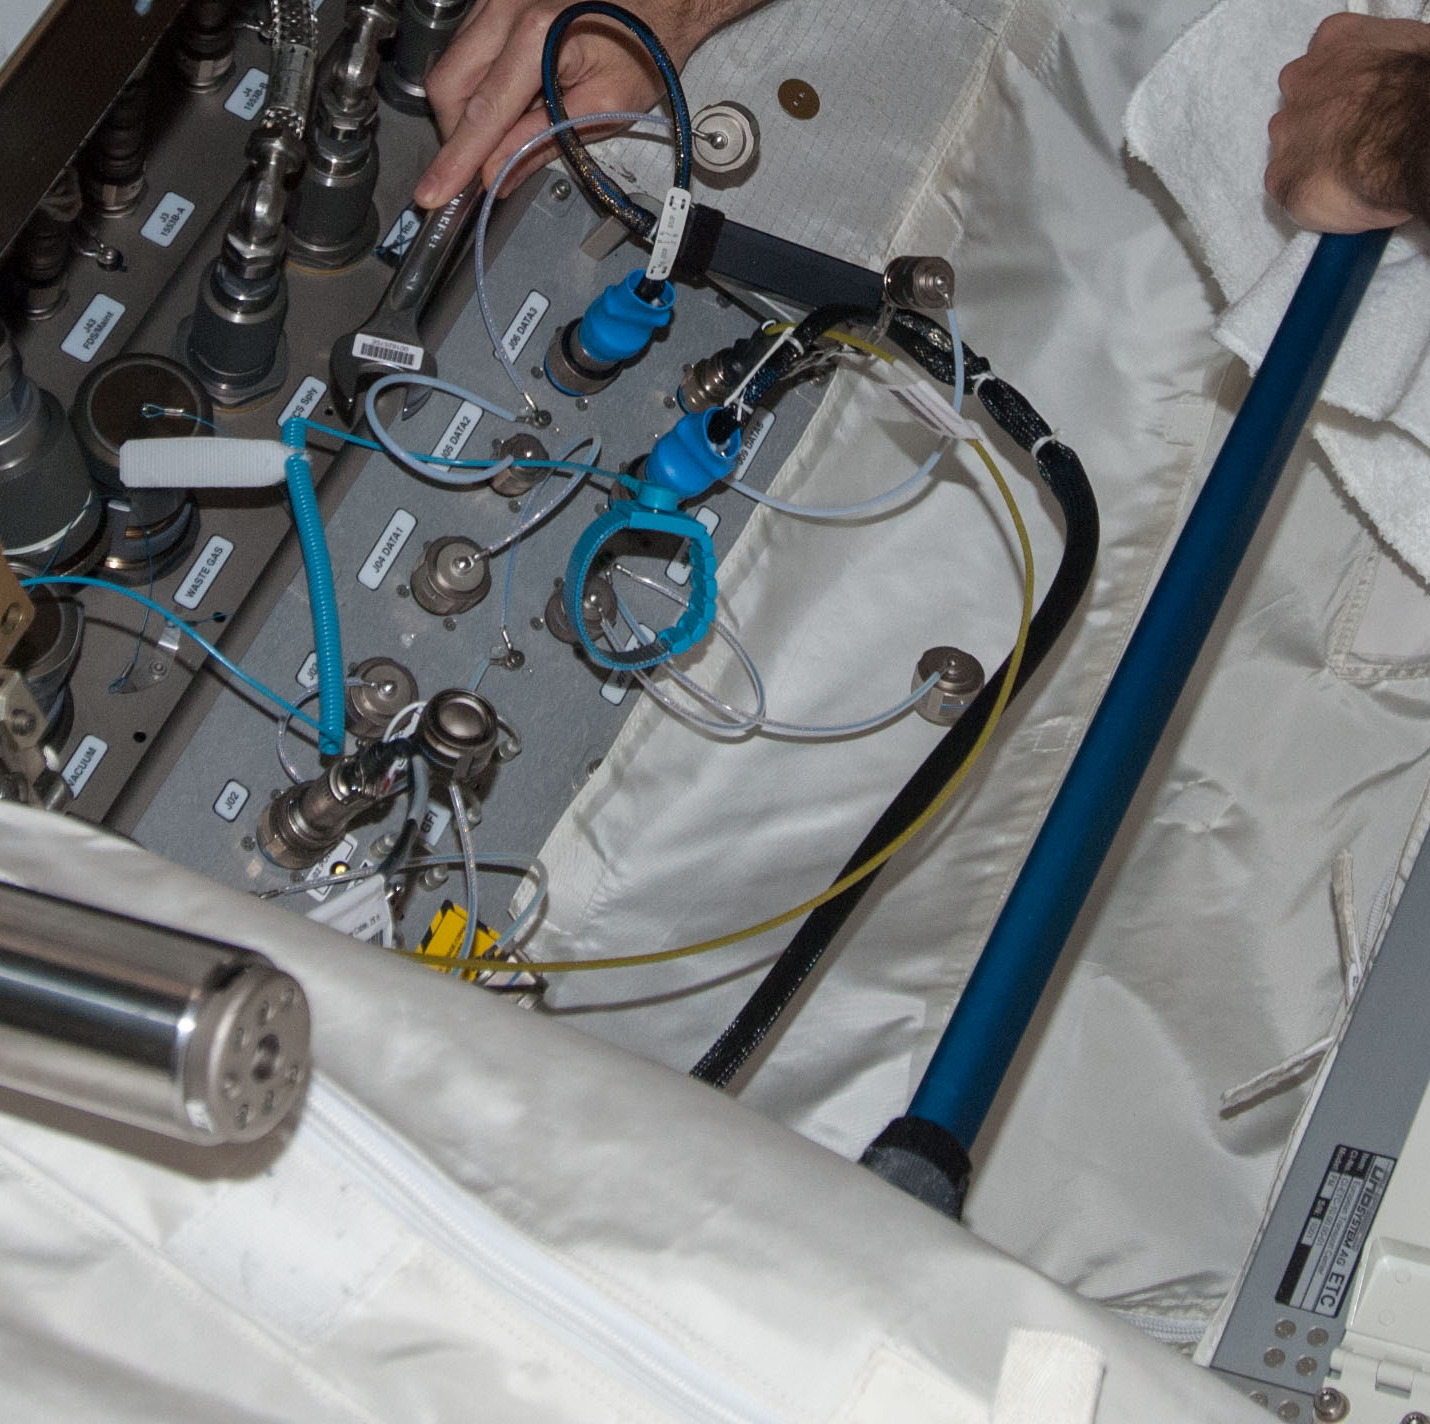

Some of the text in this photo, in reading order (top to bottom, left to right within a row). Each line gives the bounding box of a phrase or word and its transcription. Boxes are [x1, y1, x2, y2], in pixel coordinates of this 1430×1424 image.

[240, 86, 253, 98] J4
[157, 211, 170, 224] J3
[160, 205, 185, 237] 1553B-A
[81, 317, 97, 333] J43
[81, 309, 114, 351] FDS/Maint
[506, 304, 538, 351] J06 DATA3
[299, 385, 318, 407] Sply
[448, 414, 471, 445] DATA2
[370, 525, 404, 574] J04 DATA1
[184, 544, 224, 599] WASTE GAS
[222, 789, 240, 810] J02
[418, 809, 439, 833] GFI
[1318, 1205, 1366, 1308] SYSTEM AG ETC
